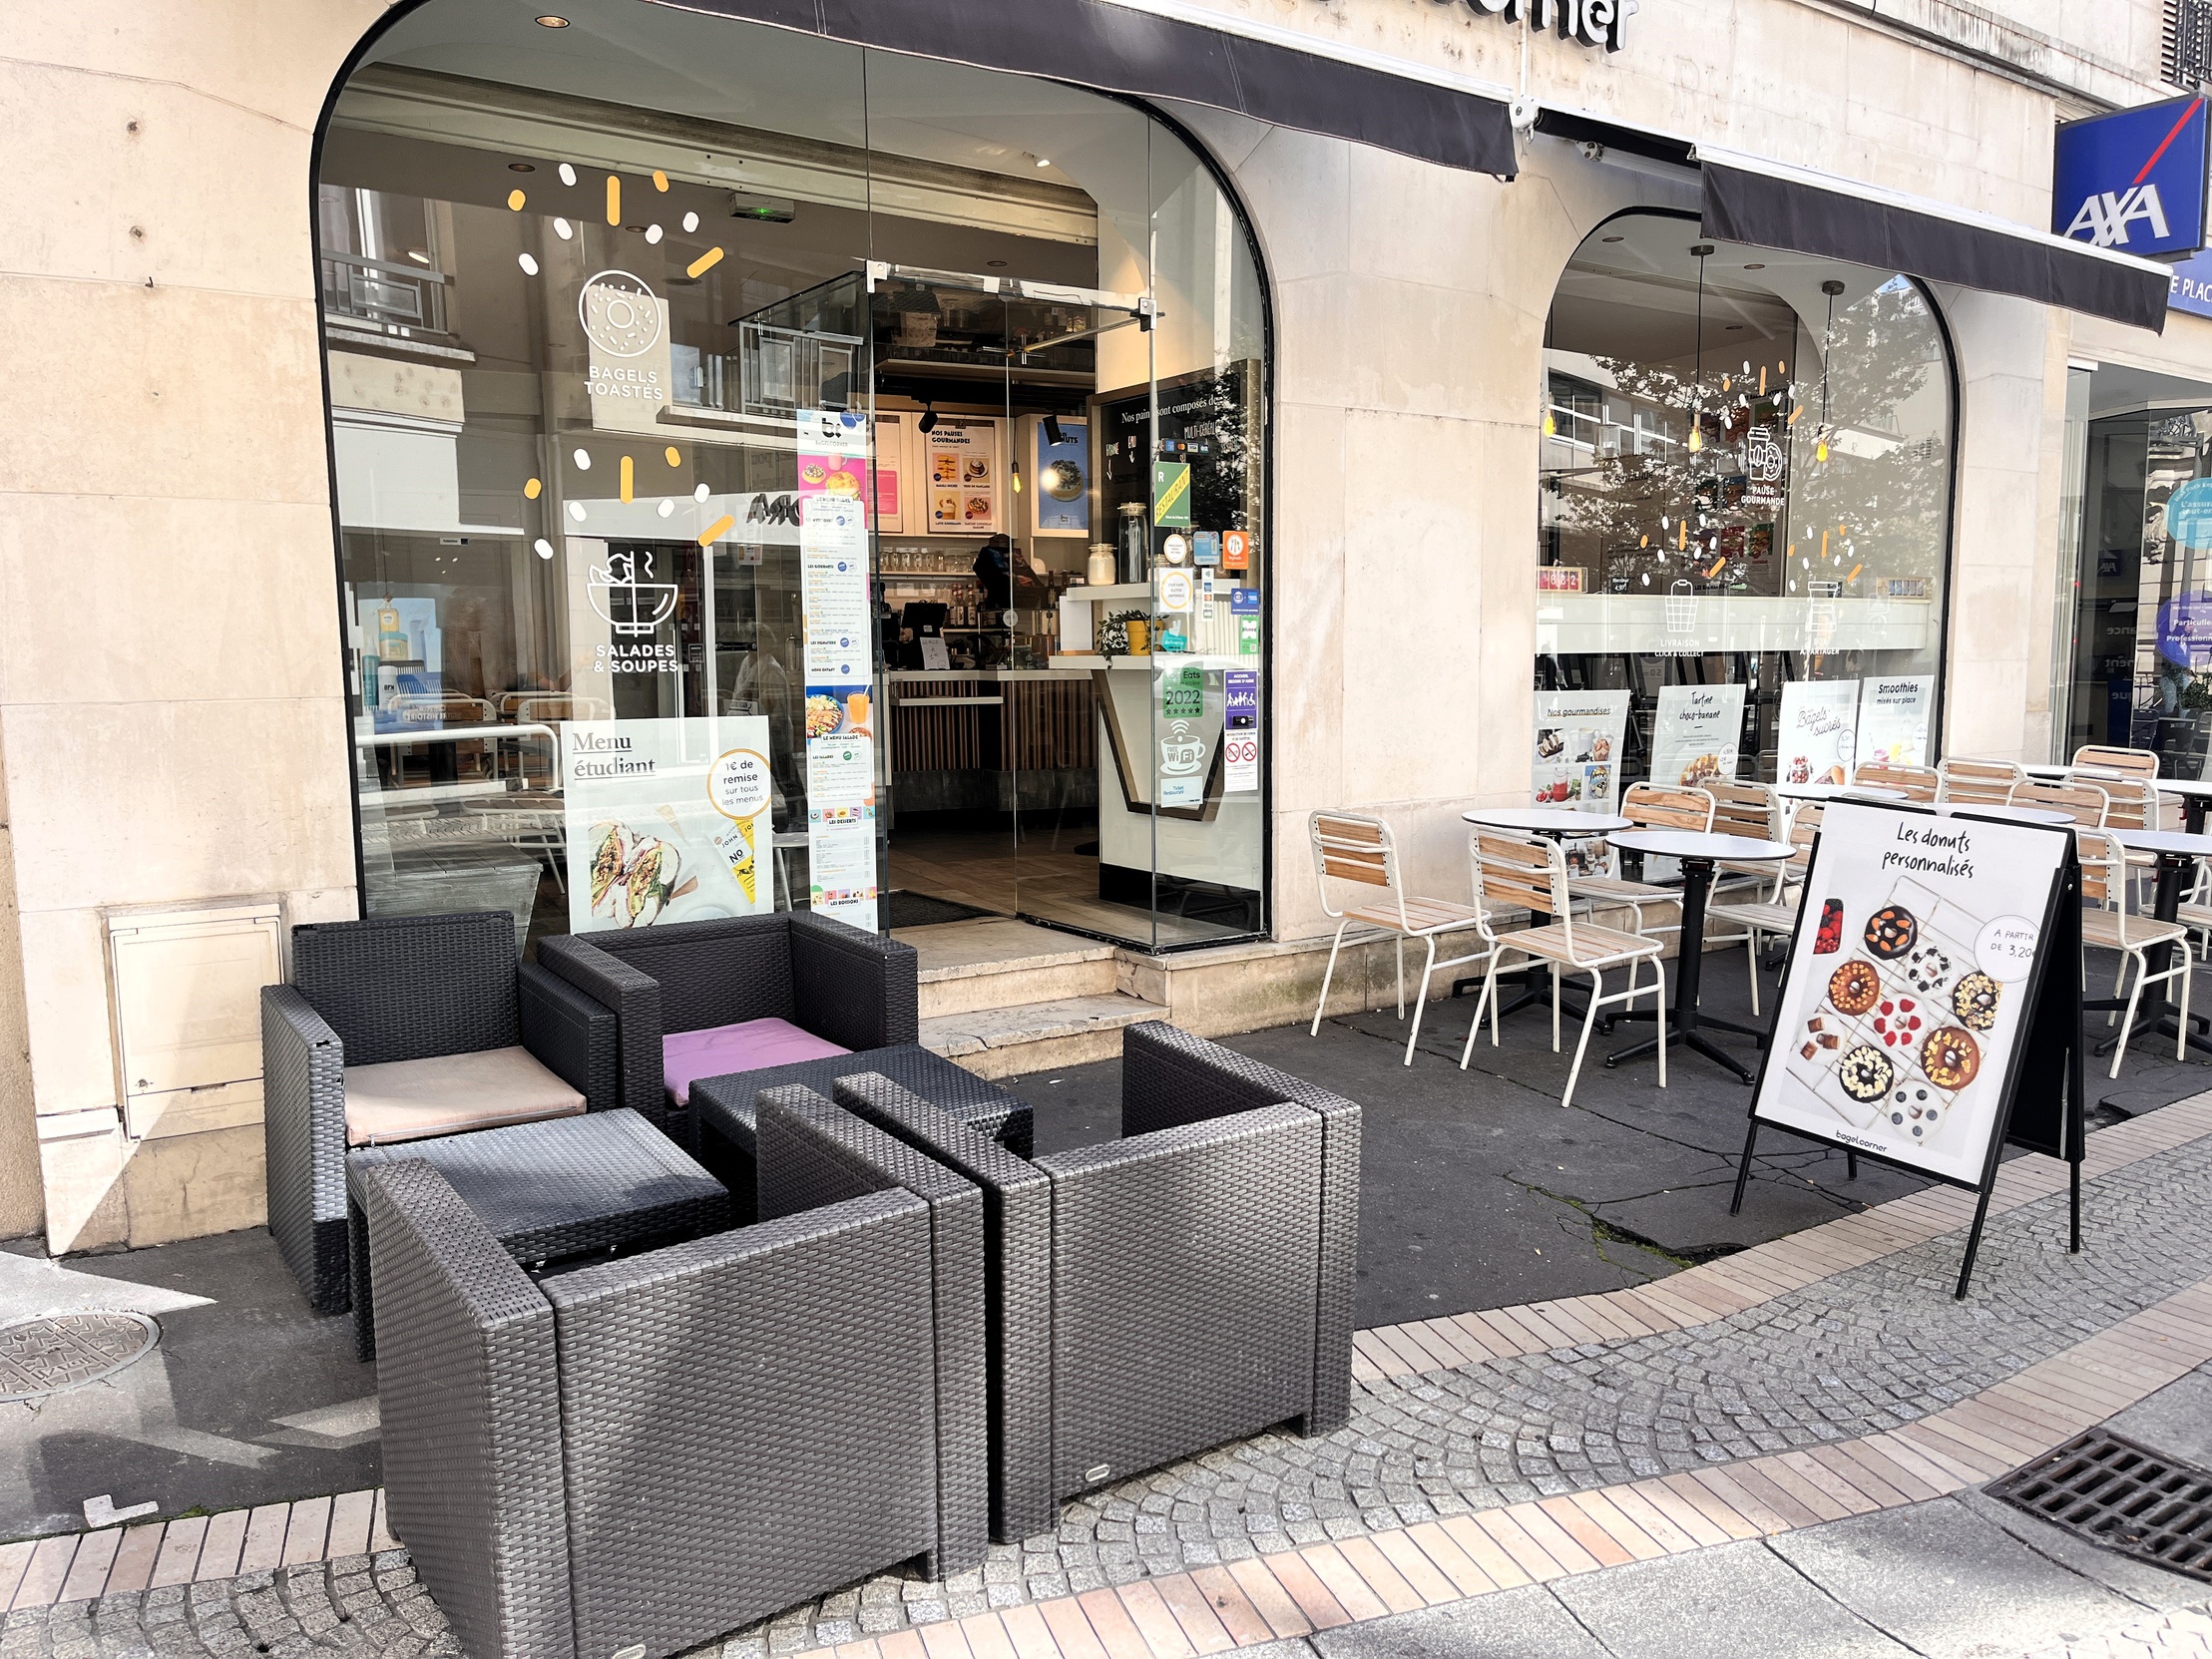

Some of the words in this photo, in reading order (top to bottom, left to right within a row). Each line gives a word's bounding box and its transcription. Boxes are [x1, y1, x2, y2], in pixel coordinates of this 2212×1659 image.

[2063, 184, 2170, 247] AXA
[589, 365, 658, 384] BAGELS
[584, 380, 663, 400] TOASTÉS
[1121, 412, 1135, 424] Nos
[1135, 408, 1151, 424] pain
[1172, 398, 1207, 415] composés
[1157, 472, 1165, 483] R
[1154, 470, 1189, 518] RESTAURANT
[1752, 485, 1776, 496] PAUSE
[1740, 495, 1786, 506] GOURMANDE
[1660, 638, 1700, 647] LIVRAISON
[596, 644, 675, 657] SALADES
[594, 659, 605, 673] &
[611, 659, 678, 673] SOUPES
[1878, 681, 1919, 694] Smoothies
[1165, 689, 1201, 705] 2022
[1691, 691, 1713, 707] Tartine
[1902, 696, 1917, 705] place
[1562, 706, 1611, 718] gourmandises
[1679, 708, 1721, 721] choco-banane
[1796, 706, 1827, 731] Bagels
[573, 732, 632, 750] Menu
[575, 757, 656, 777] étudiant
[725, 762, 737, 771] 1€
[739, 761, 753, 770] de
[723, 774, 758, 784] remise
[740, 784, 758, 794] tous
[722, 797, 734, 806] les
[736, 795, 763, 804] menus
[721, 834, 738, 848] JOHN
[1897, 821, 1920, 844] Les
[1921, 827, 1972, 854] donuts
[728, 849, 744, 863] NO
[1882, 850, 1975, 879] personnalisés
[2004, 931, 2034, 941] PARTIR
[1991, 943, 2002, 952] DE
[1836, 1129, 1888, 1152] bagelcorner
